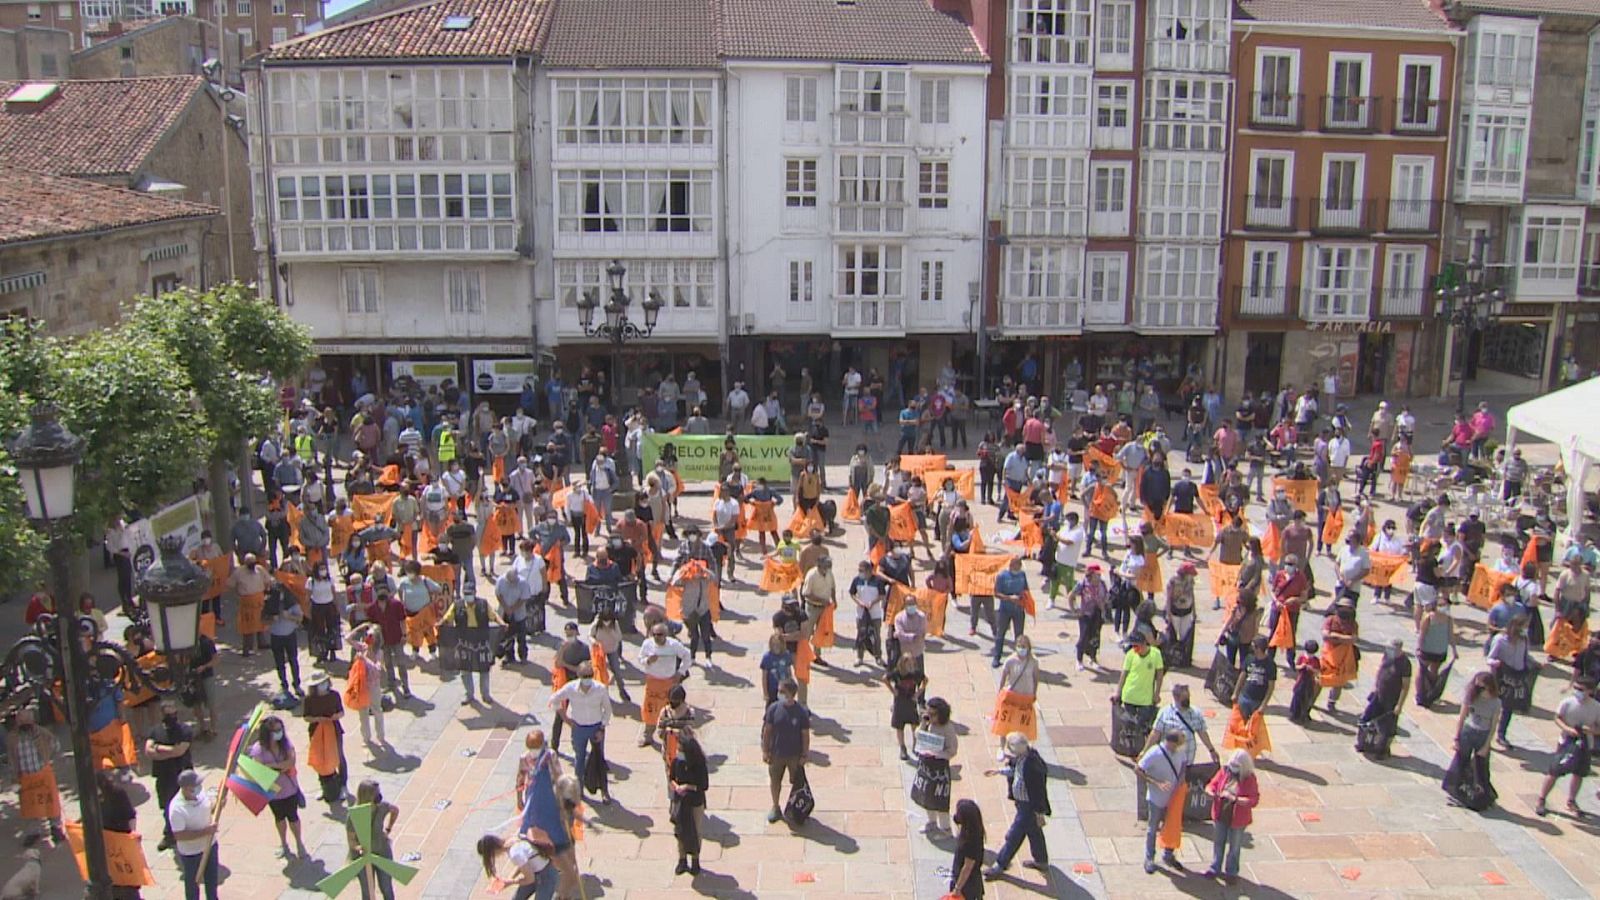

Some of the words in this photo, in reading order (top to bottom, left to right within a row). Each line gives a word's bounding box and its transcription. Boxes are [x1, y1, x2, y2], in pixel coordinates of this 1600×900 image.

[710, 445, 757, 458] RAL
[1190, 794, 1206, 807] NO
[115, 862, 133, 874] NO
